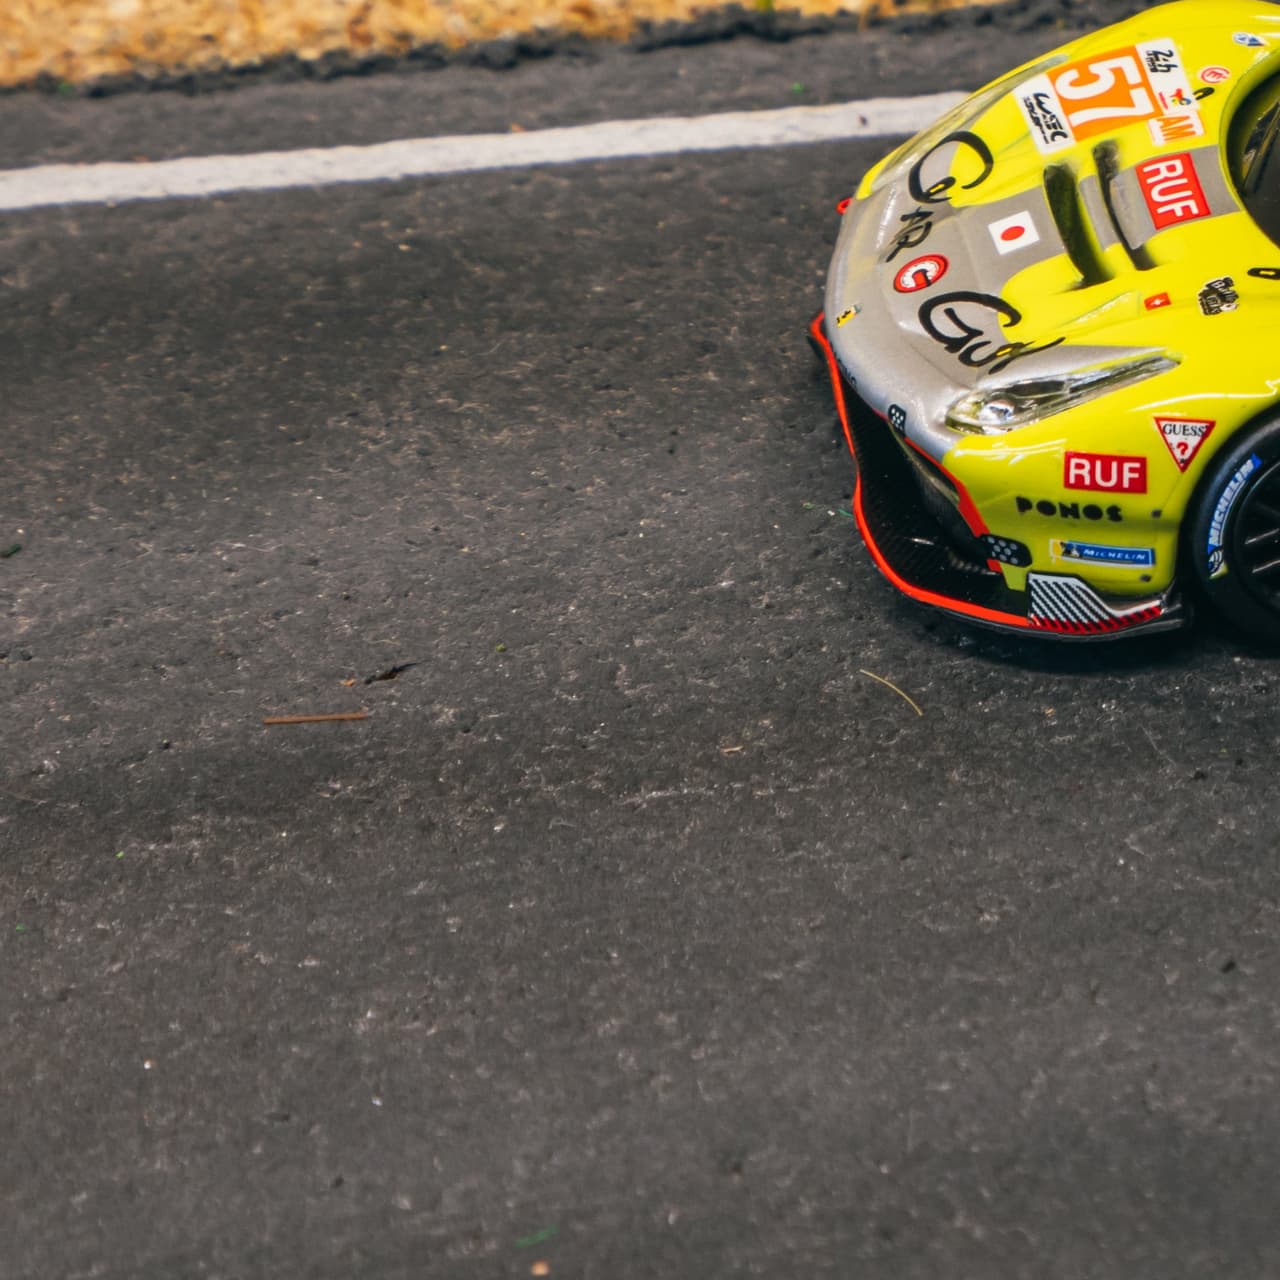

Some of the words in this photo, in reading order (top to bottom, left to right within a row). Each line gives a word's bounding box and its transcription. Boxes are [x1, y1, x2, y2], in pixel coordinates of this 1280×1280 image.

[1055, 55, 1155, 127] 57
[1157, 115, 1197, 141] AM
[1142, 158, 1199, 219] RUF
[1162, 422, 1207, 438] GUESS
[1068, 457, 1142, 489] RUF
[1015, 496, 1123, 522] PONOS
[1208, 457, 1255, 546] MICHELIN
[1082, 548, 1147, 561] MICHELIN
